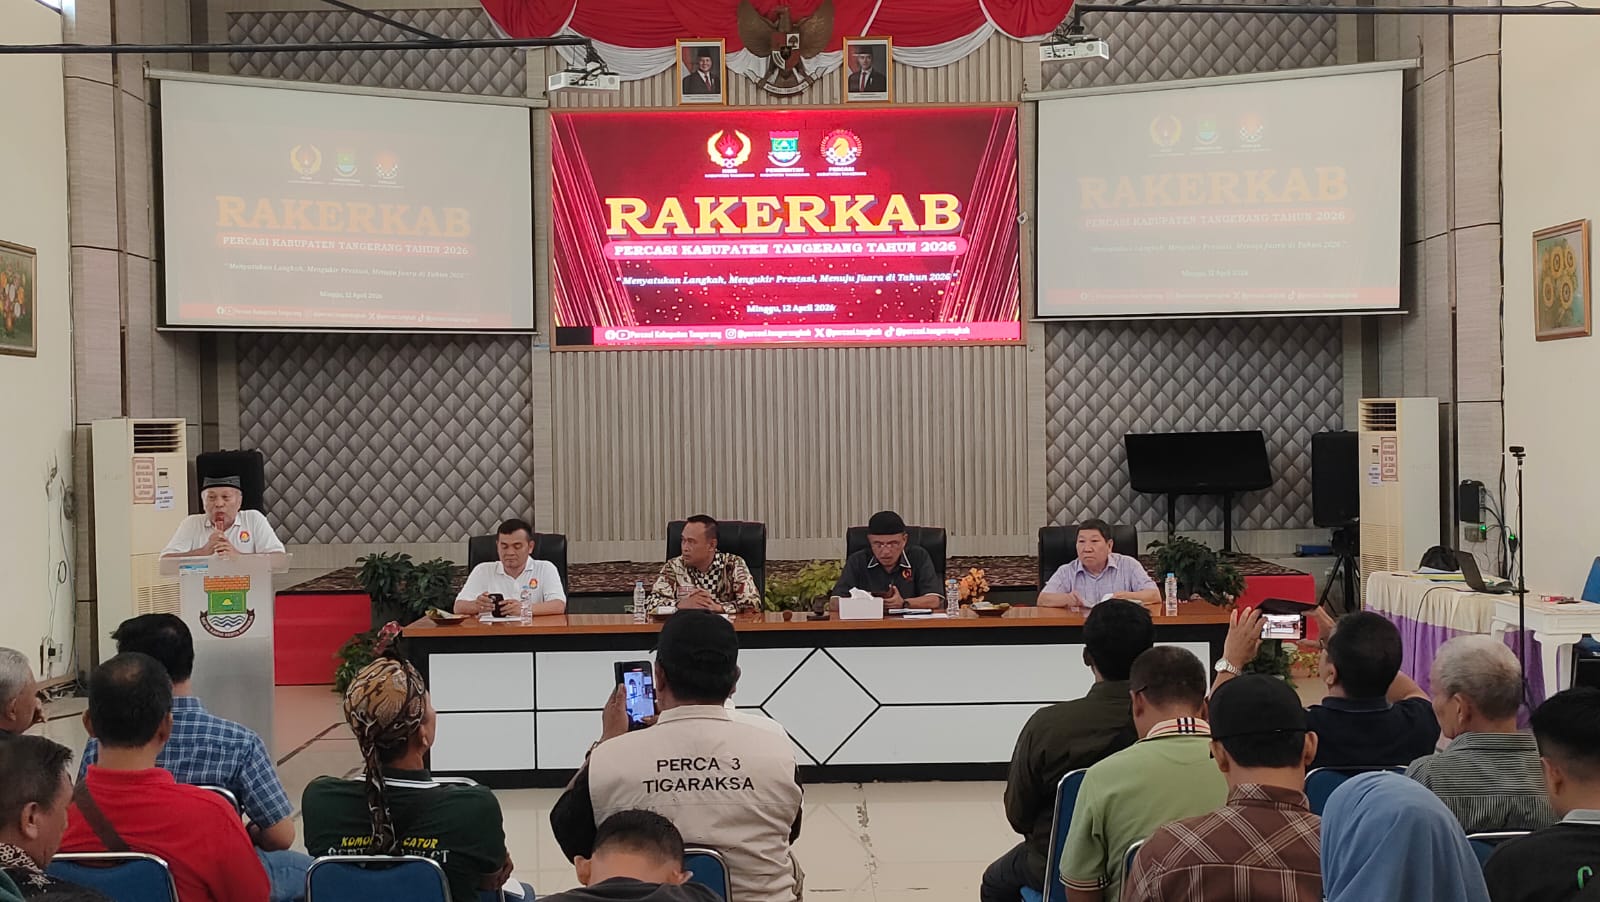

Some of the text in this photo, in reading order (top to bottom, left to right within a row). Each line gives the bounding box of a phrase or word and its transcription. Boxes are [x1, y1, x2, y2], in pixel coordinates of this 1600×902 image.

[1078, 166, 1349, 209] RAKERKAB
[215, 195, 471, 238] RAKERKAB
[605, 194, 964, 238] RAKERKAB
[1316, 210, 1345, 221] 2026
[223, 236, 469, 255] PERCASI KABUPATEN TANGERANG TAHUN 2026
[613, 241, 957, 256] PERCASI KABUPATEN TANGERANG TAHUN 2026
[683, 275, 727, 287] Langkah,
[729, 274, 774, 286] Mengukir
[775, 274, 817, 284] Prestasi,
[819, 273, 855, 284] Menuju
[854, 274, 883, 284] Juara
[885, 273, 896, 282] di
[897, 273, 927, 282] Tahun
[746, 304, 781, 315] Minggu,
[792, 304, 813, 313] April
[814, 303, 836, 312] 2026
[656, 757, 741, 773] PERCA 3
[642, 776, 755, 794] TIGARAKSA
[403, 837, 438, 849] CATUR
